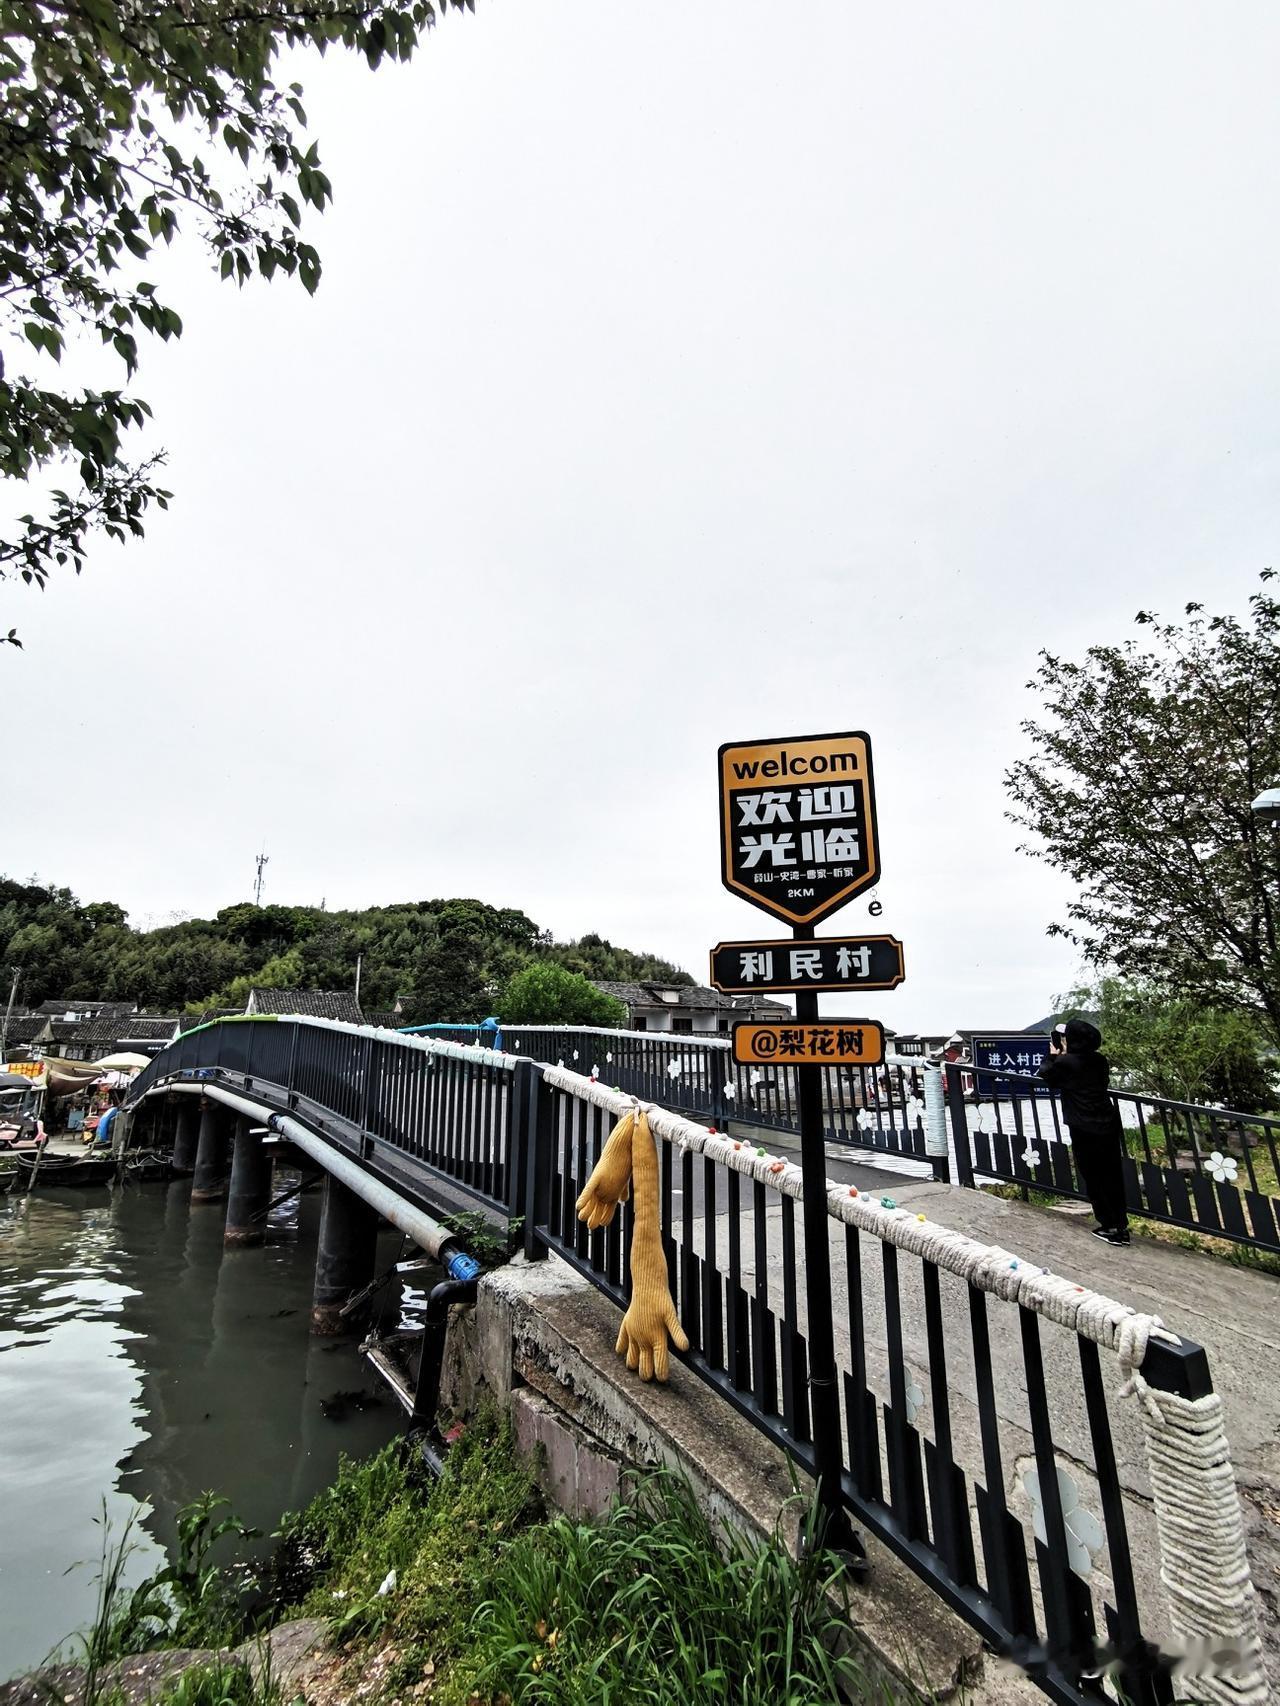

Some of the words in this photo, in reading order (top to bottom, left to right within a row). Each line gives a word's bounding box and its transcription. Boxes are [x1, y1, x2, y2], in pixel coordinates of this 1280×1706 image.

[733, 751, 858, 780] welcom
[736, 785, 857, 827] 欢迎
[739, 827, 860, 869] 光临
[787, 888, 814, 898] 2KM
[739, 945, 872, 982] 利民村
[751, 1028, 864, 1059] @梨花树
[988, 1052, 1044, 1066] 进入村庄
